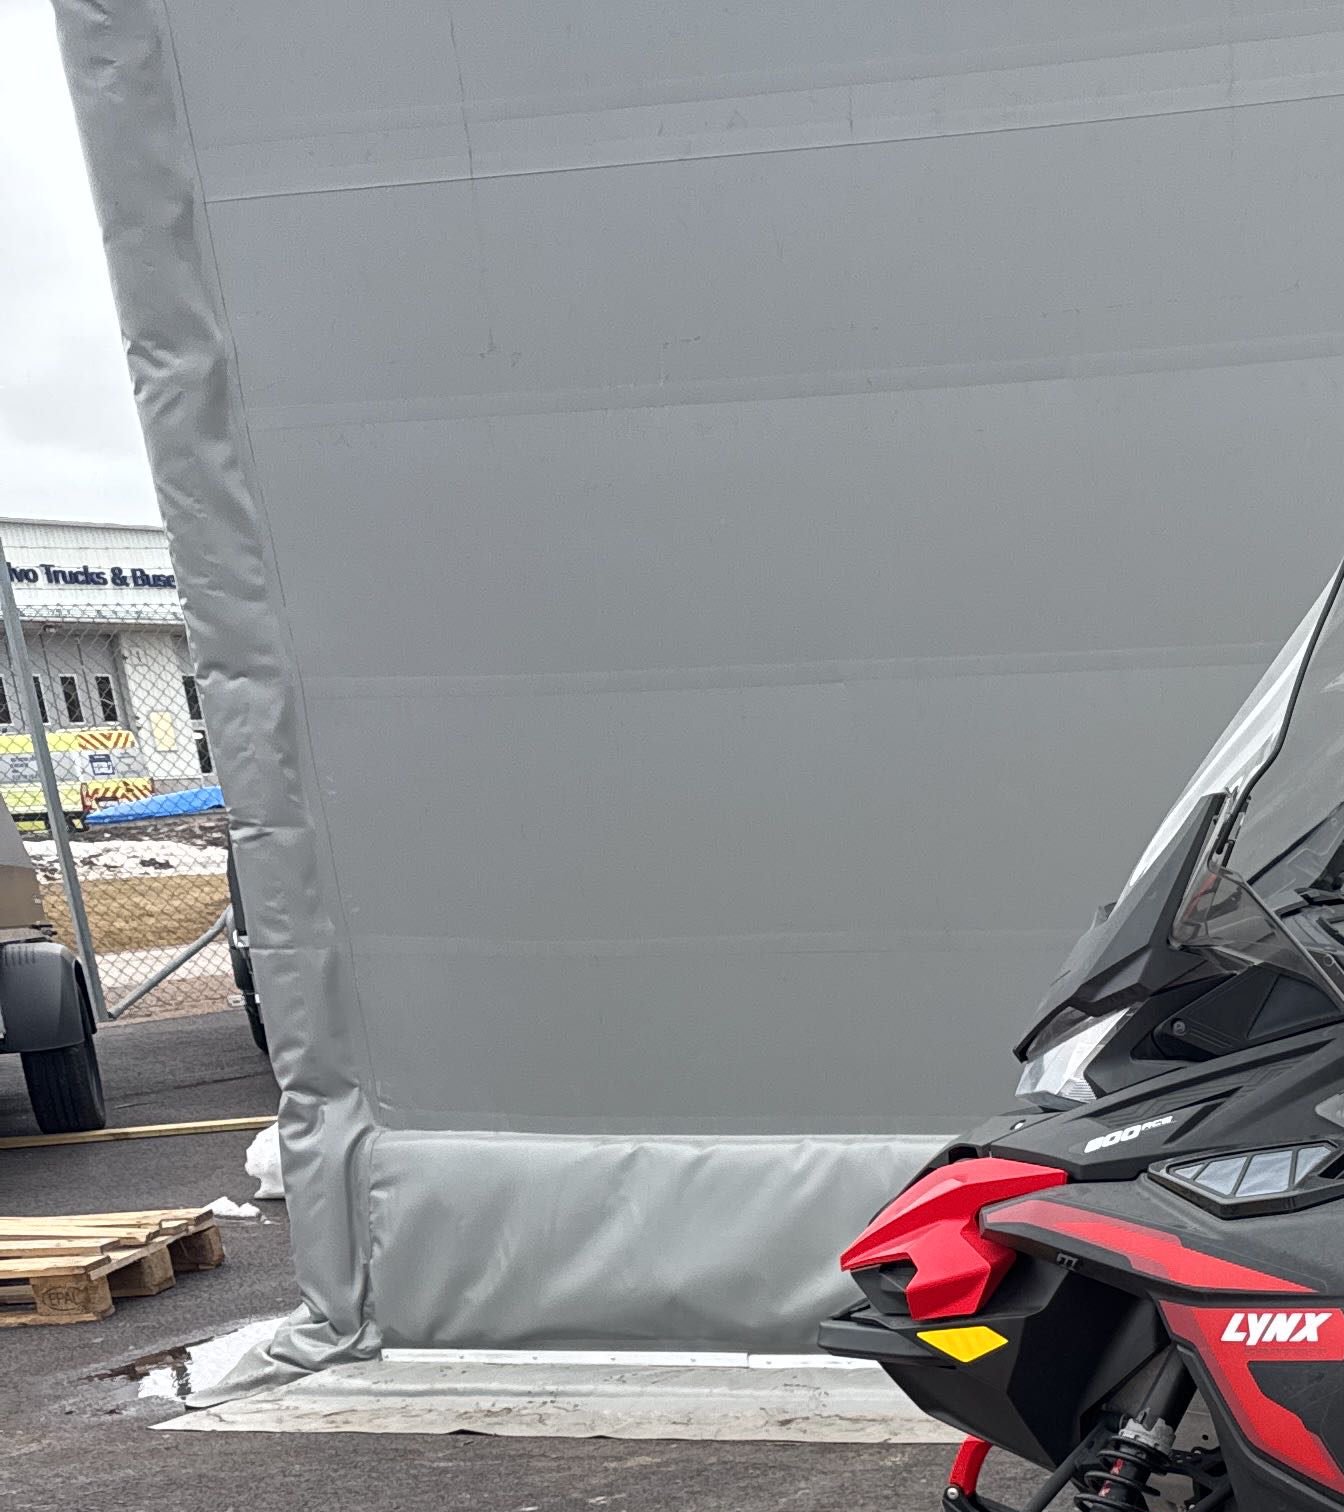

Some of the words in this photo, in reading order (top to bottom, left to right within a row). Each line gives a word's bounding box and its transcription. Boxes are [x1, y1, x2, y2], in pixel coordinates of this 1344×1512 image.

[39, 564, 108, 586] Trucks
[111, 566, 130, 587] &
[1221, 1313, 1333, 1346] LYNX
